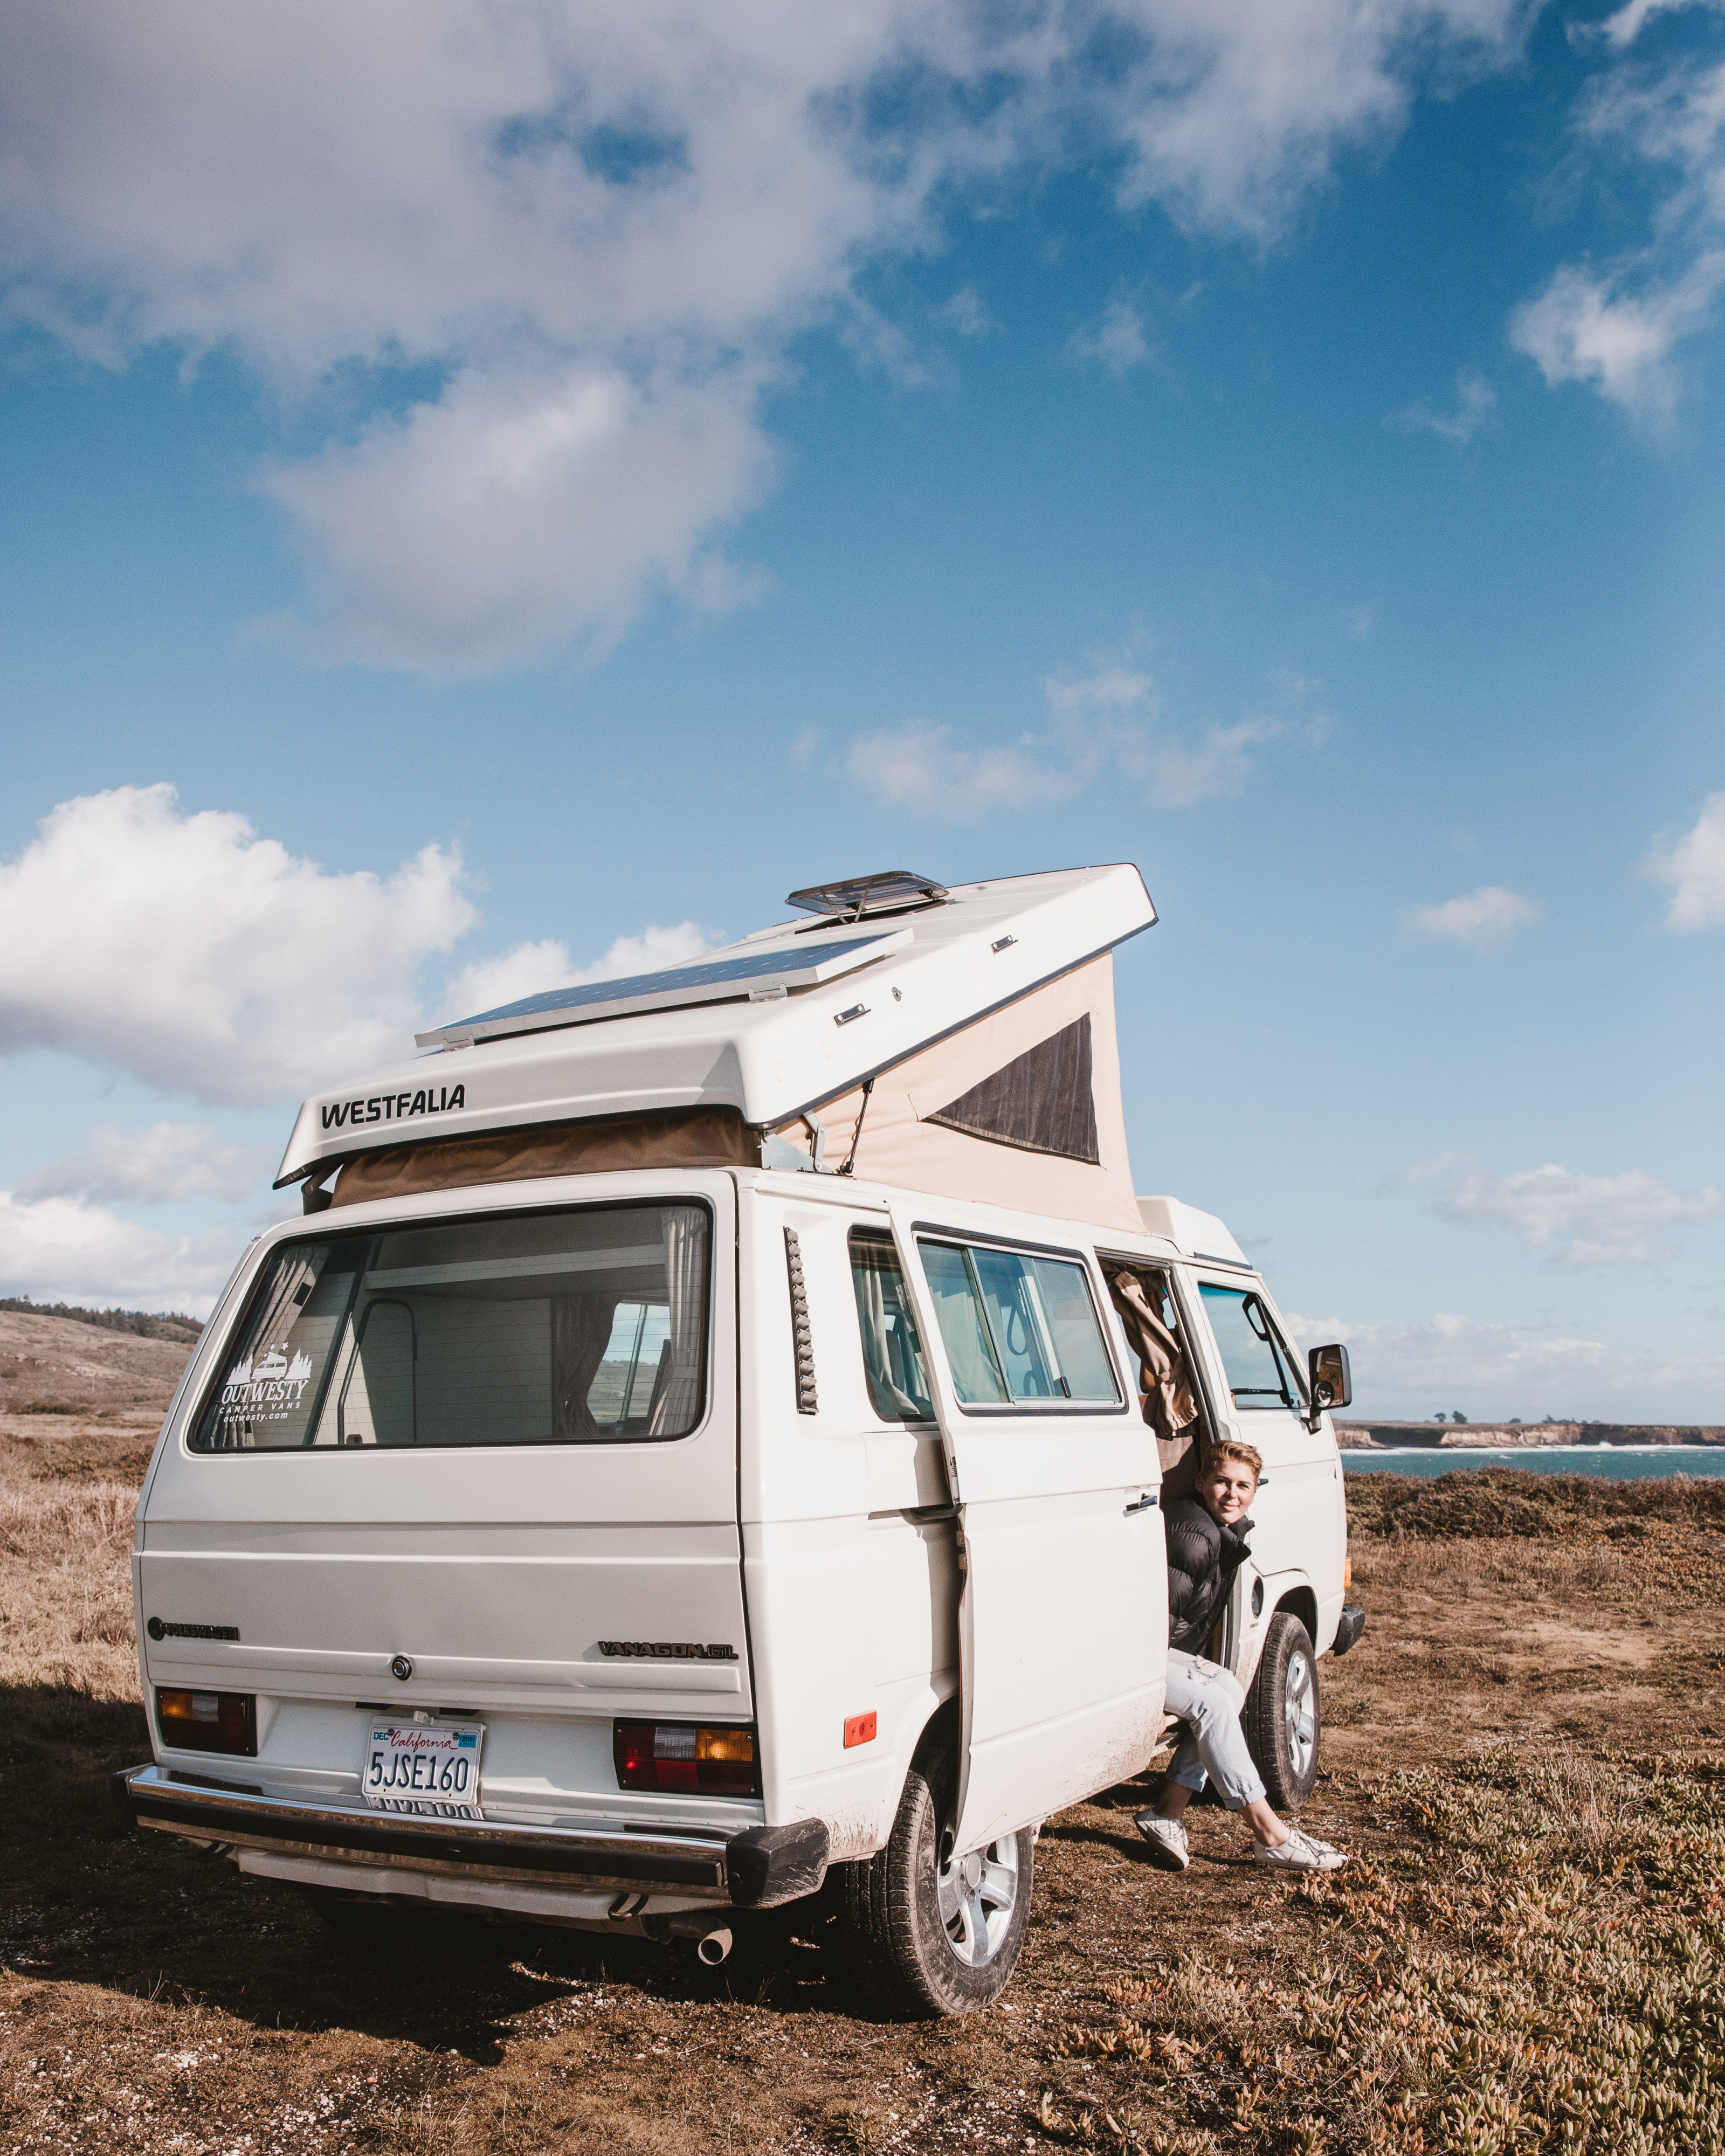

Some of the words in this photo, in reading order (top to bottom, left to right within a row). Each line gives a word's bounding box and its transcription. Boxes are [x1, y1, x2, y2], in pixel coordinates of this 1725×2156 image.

[322, 1084, 465, 1129] WESTFALIA
[222, 1379, 309, 1405] OUTWESTY
[219, 1404, 264, 1414] CAMPER
[271, 1401, 301, 1411] VANS
[223, 1412, 288, 1423] outwesty.com
[164, 1623, 240, 1641] VOLKSWAGEN
[598, 1641, 702, 1659] VANAGON
[707, 1644, 739, 1660] GL
[373, 1731, 389, 1741] DEC
[391, 1730, 458, 1753] California
[369, 1751, 469, 1792] 5JSE160
